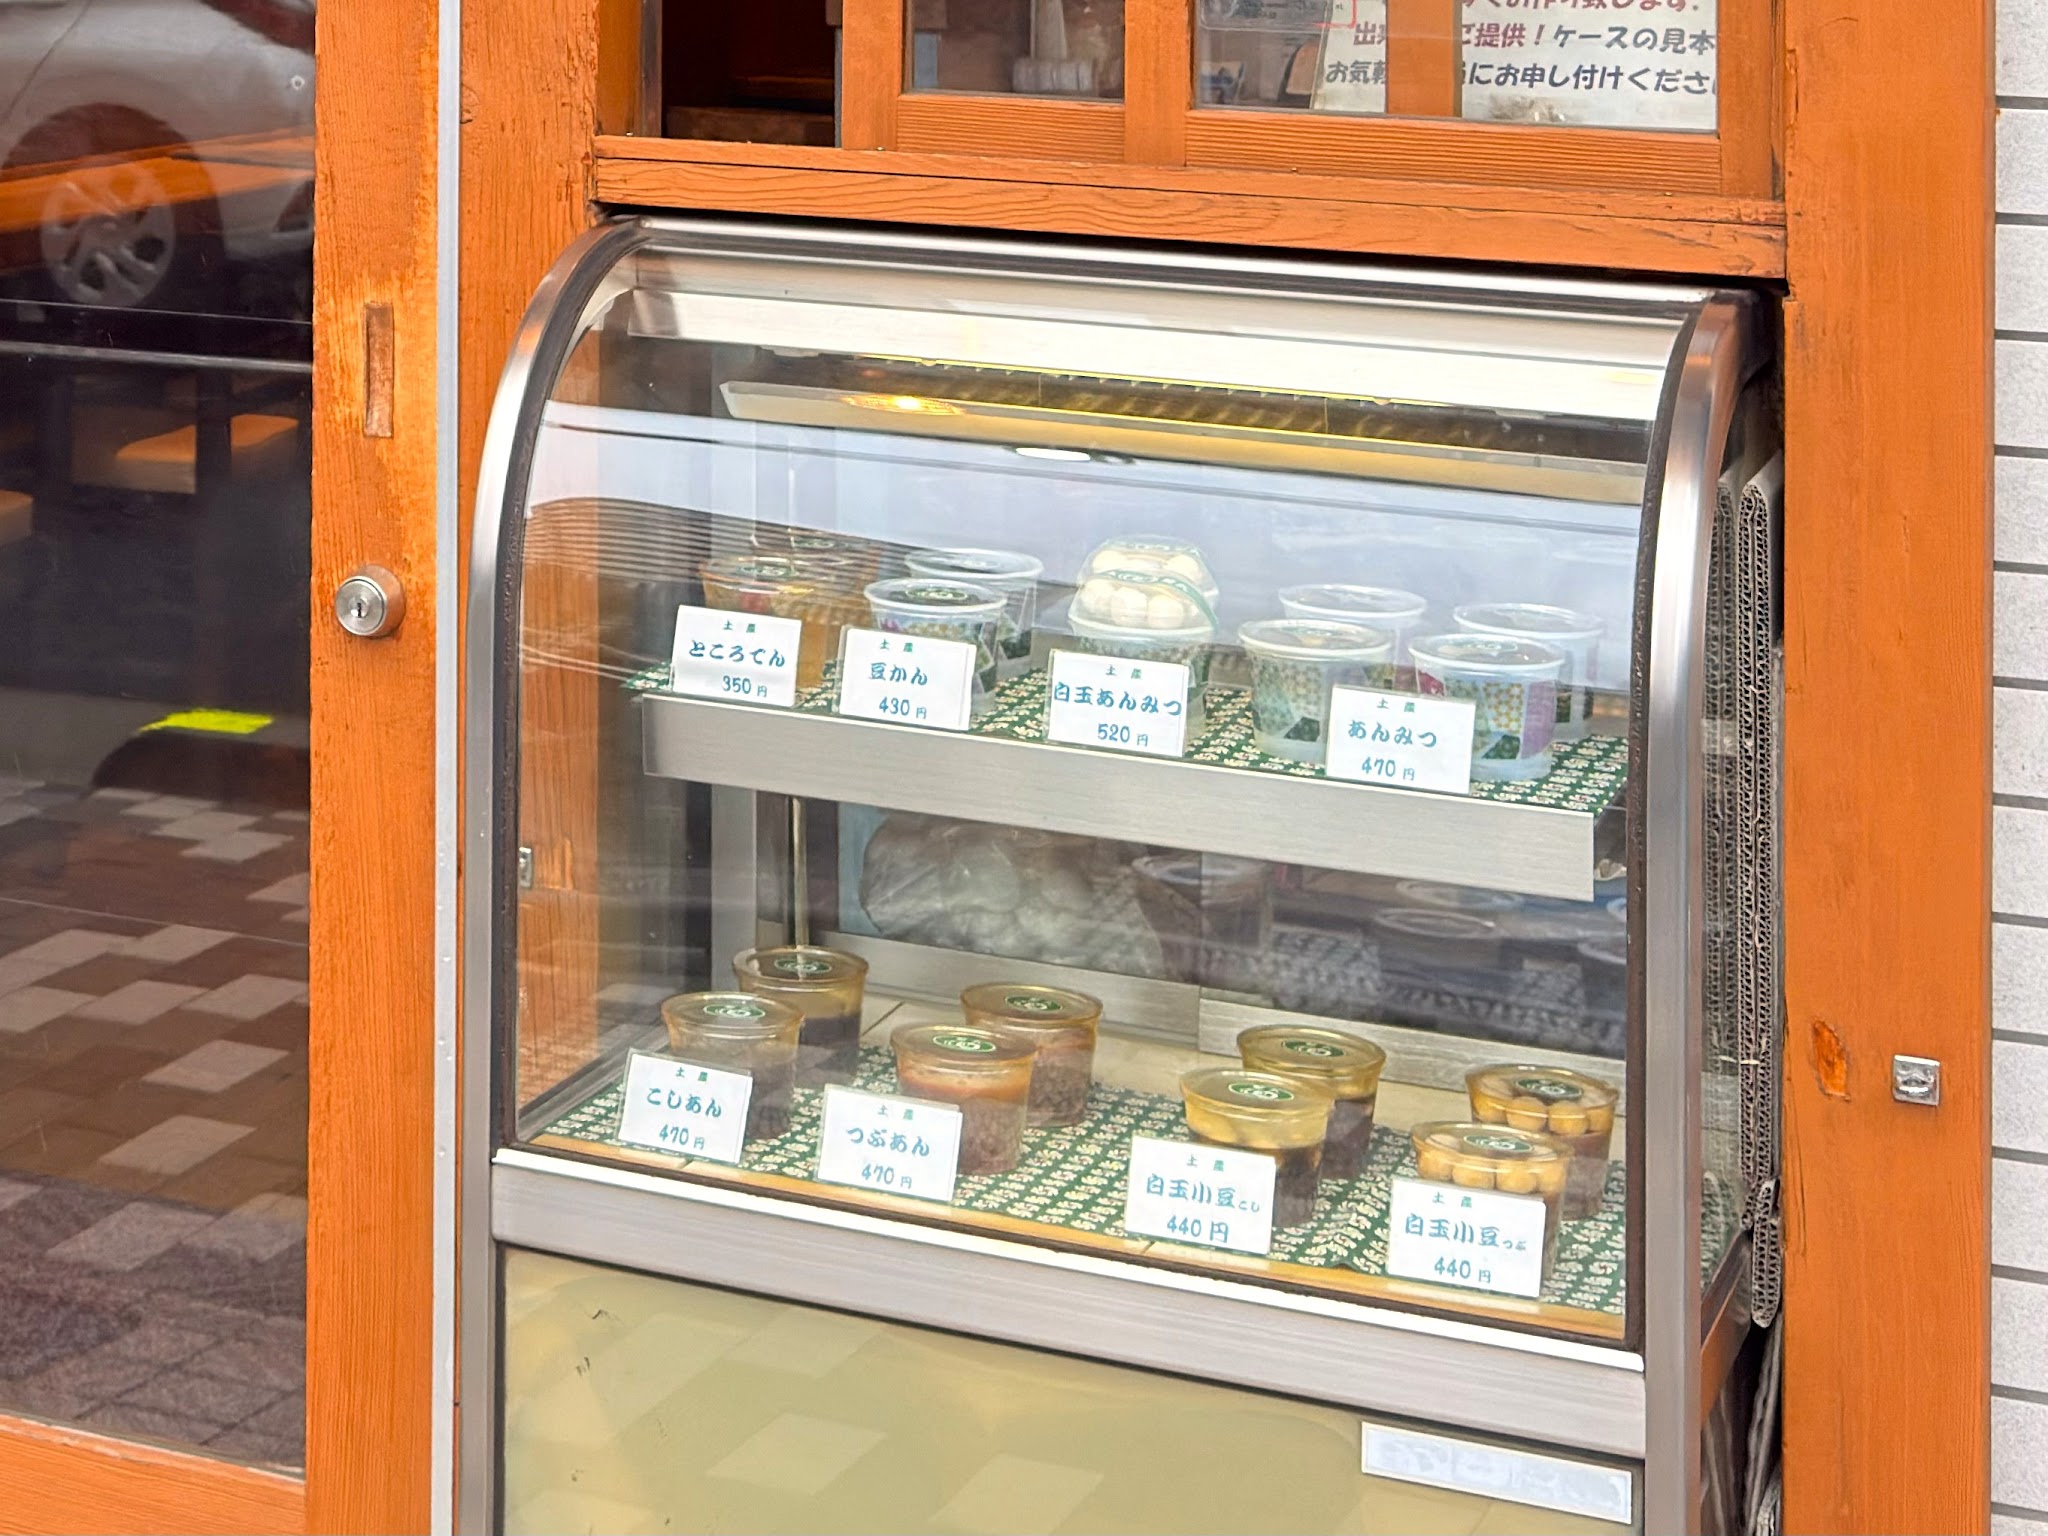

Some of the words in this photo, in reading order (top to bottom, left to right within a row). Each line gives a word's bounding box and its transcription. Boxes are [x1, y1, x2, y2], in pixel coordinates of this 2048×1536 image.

[1462, 61, 1716, 94] にお申し付けくださ
[689, 640, 785, 667] ところてん
[871, 662, 927, 685] 豆かん
[1053, 682, 1183, 717] 白玉あんみつ
[1348, 720, 1436, 747] あんみつ
[647, 1088, 721, 1117] こしあん
[848, 1128, 929, 1156] つぶあん
